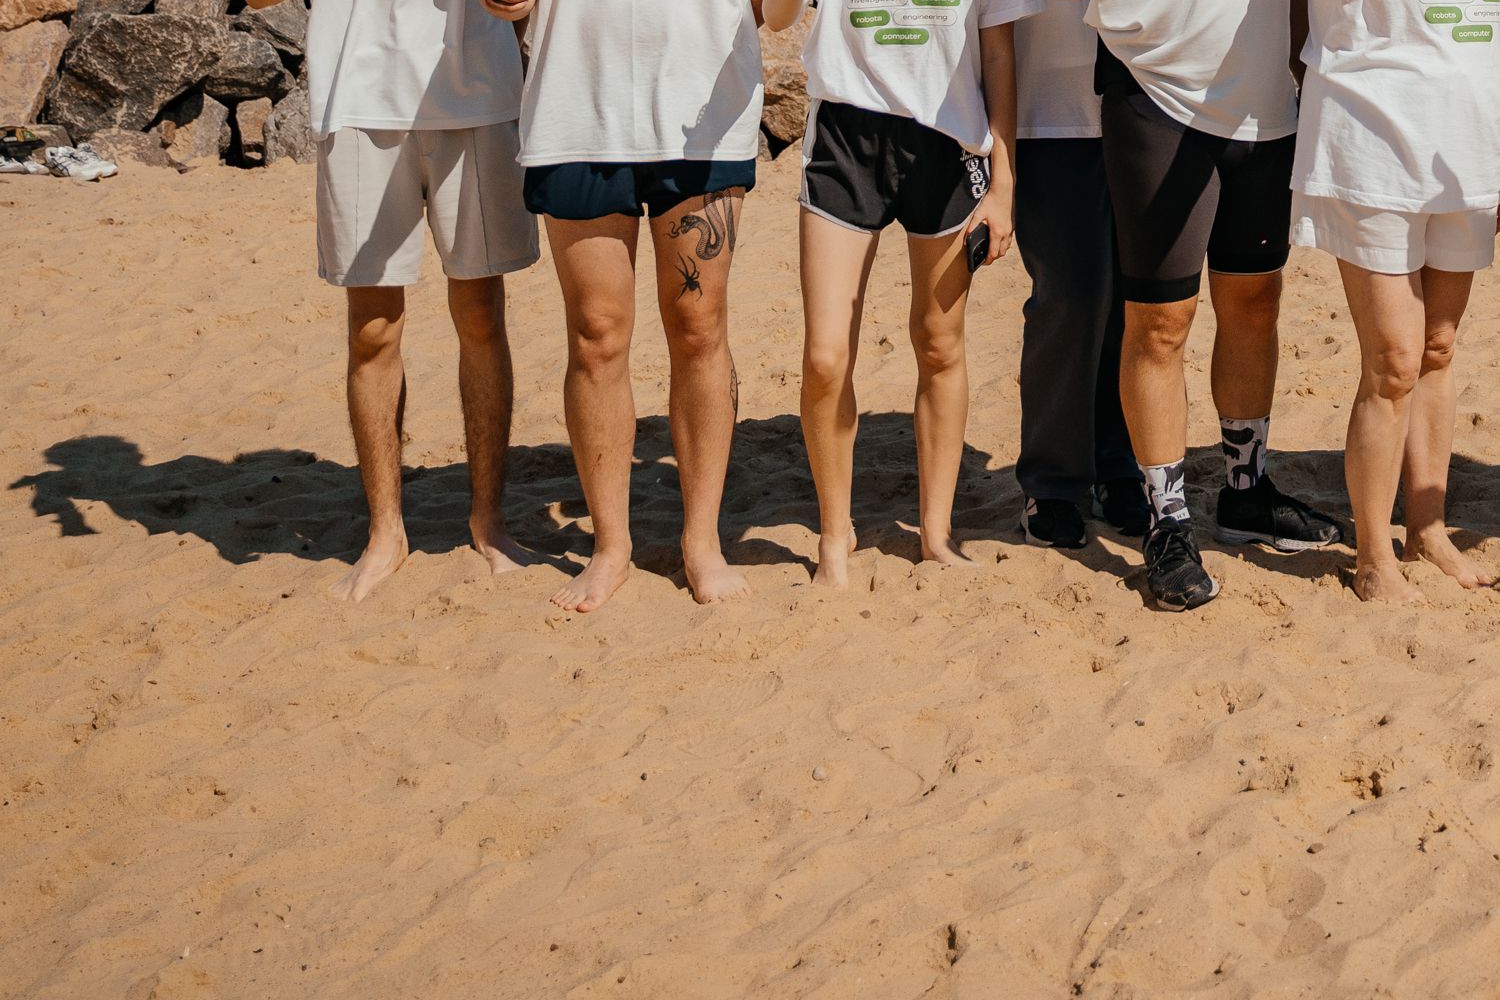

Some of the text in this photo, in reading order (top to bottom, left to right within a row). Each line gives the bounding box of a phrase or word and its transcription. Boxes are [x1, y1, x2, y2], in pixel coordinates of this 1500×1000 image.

[856, 13, 948, 23] robots engineering
[1432, 11, 1456, 19] robots
[882, 32, 922, 41] computer
[1458, 30, 1491, 38] computer
